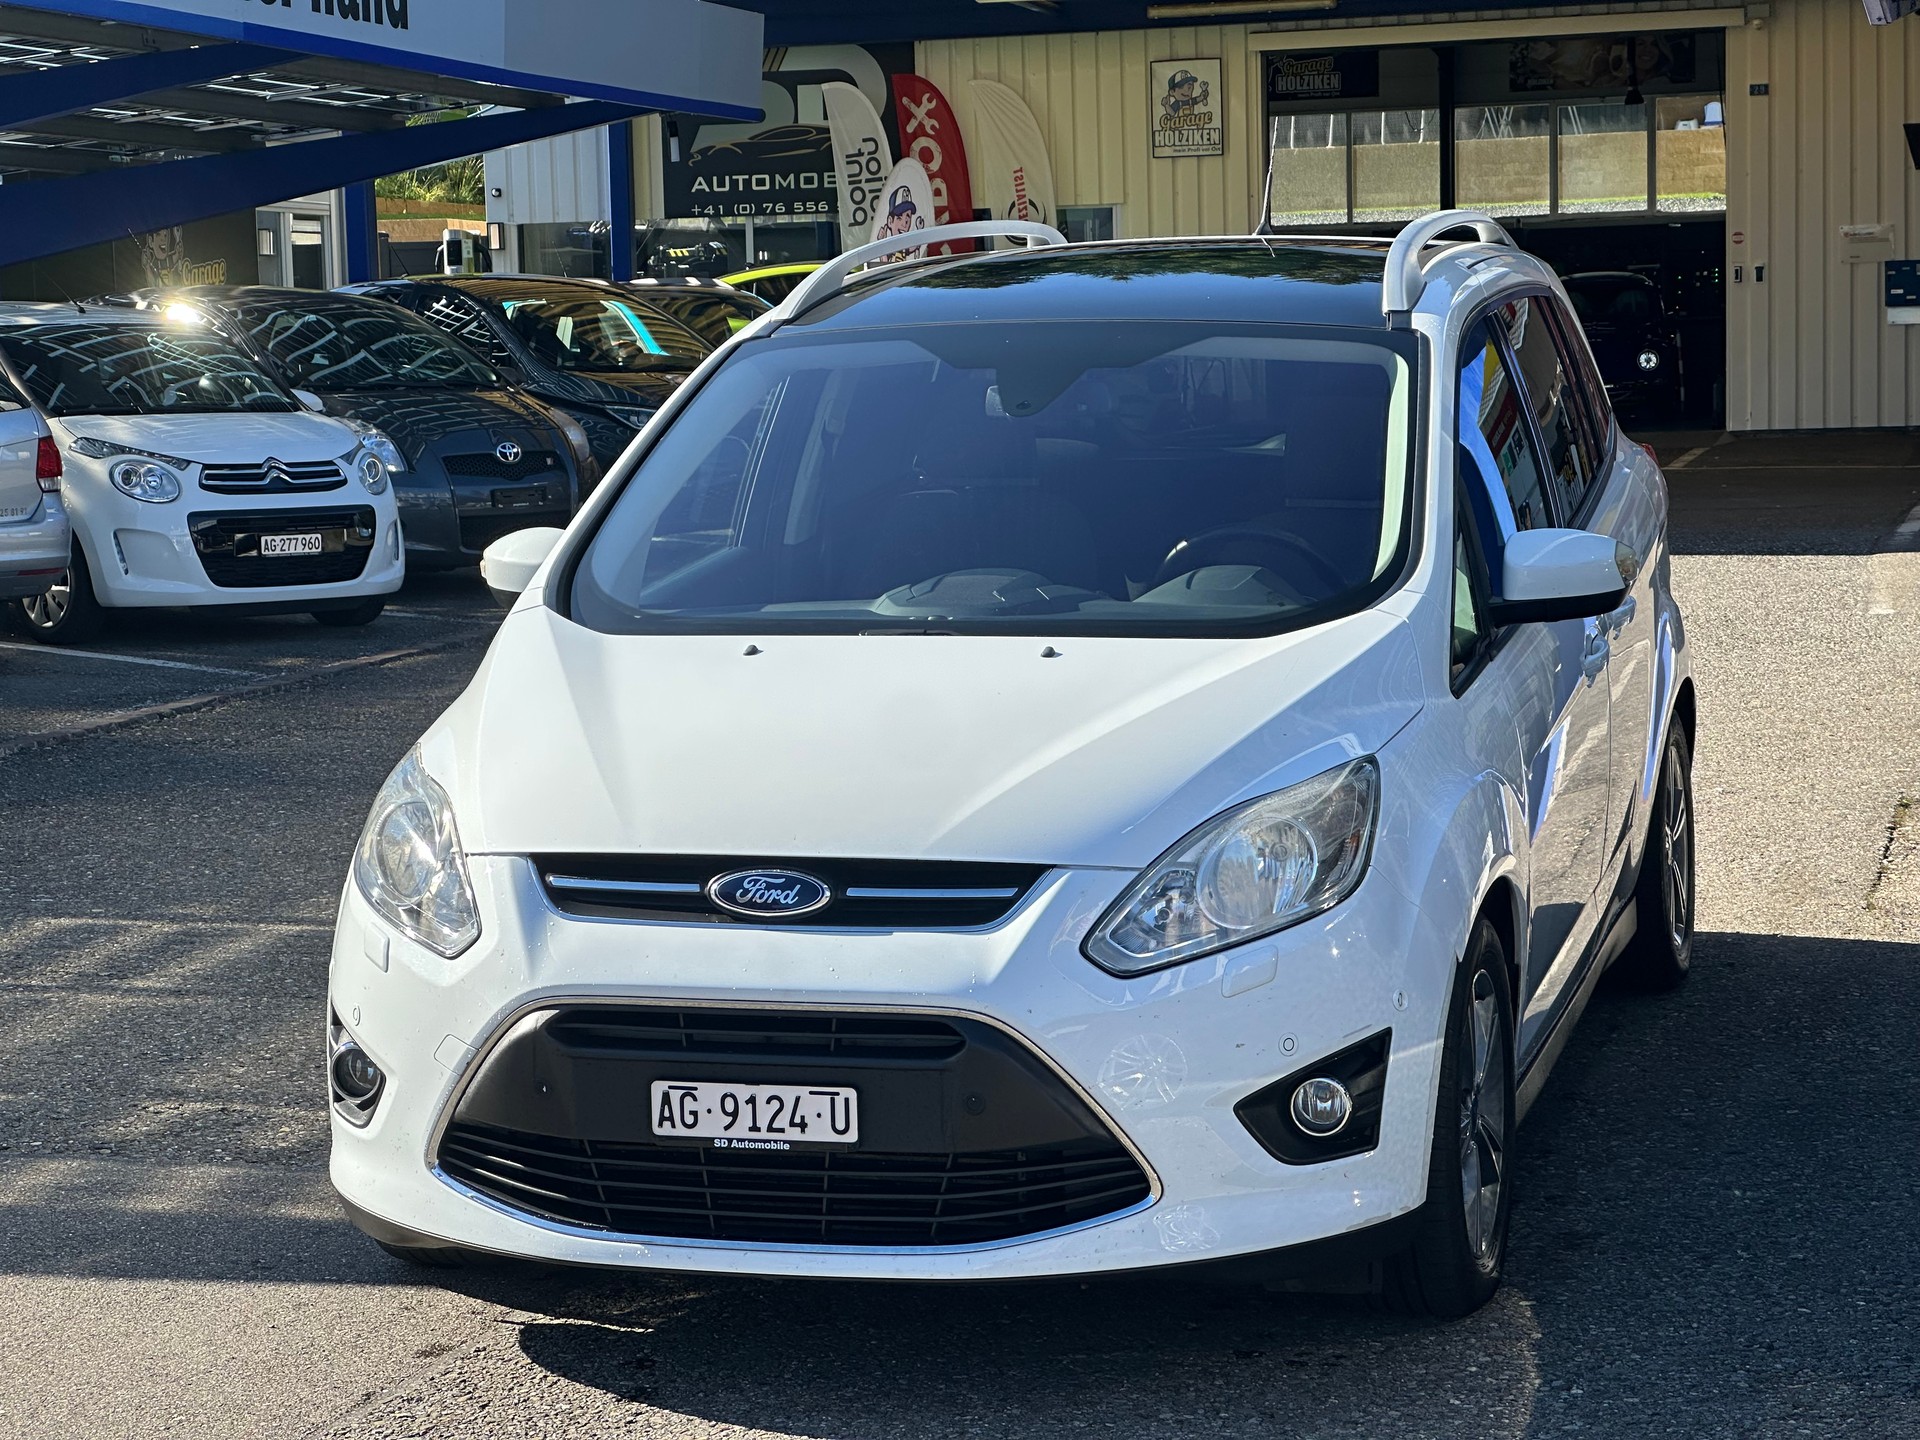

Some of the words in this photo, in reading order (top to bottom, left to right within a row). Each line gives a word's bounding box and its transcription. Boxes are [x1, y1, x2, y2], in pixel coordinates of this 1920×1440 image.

[1283, 58, 1333, 76] Garage
[1277, 73, 1340, 91] HOLZIKEN
[1160, 111, 1212, 131] Garage
[1154, 128, 1220, 147] HOLZIKEN
[691, 204, 723, 215] +41
[734, 203, 755, 214] (0)
[763, 202, 785, 213] 76
[794, 201, 828, 212] 556
[182, 258, 226, 285] Garage
[735, 876, 801, 904] Ford
[713, 1138, 728, 1148] SD
[730, 1139, 790, 1150] Automobile
